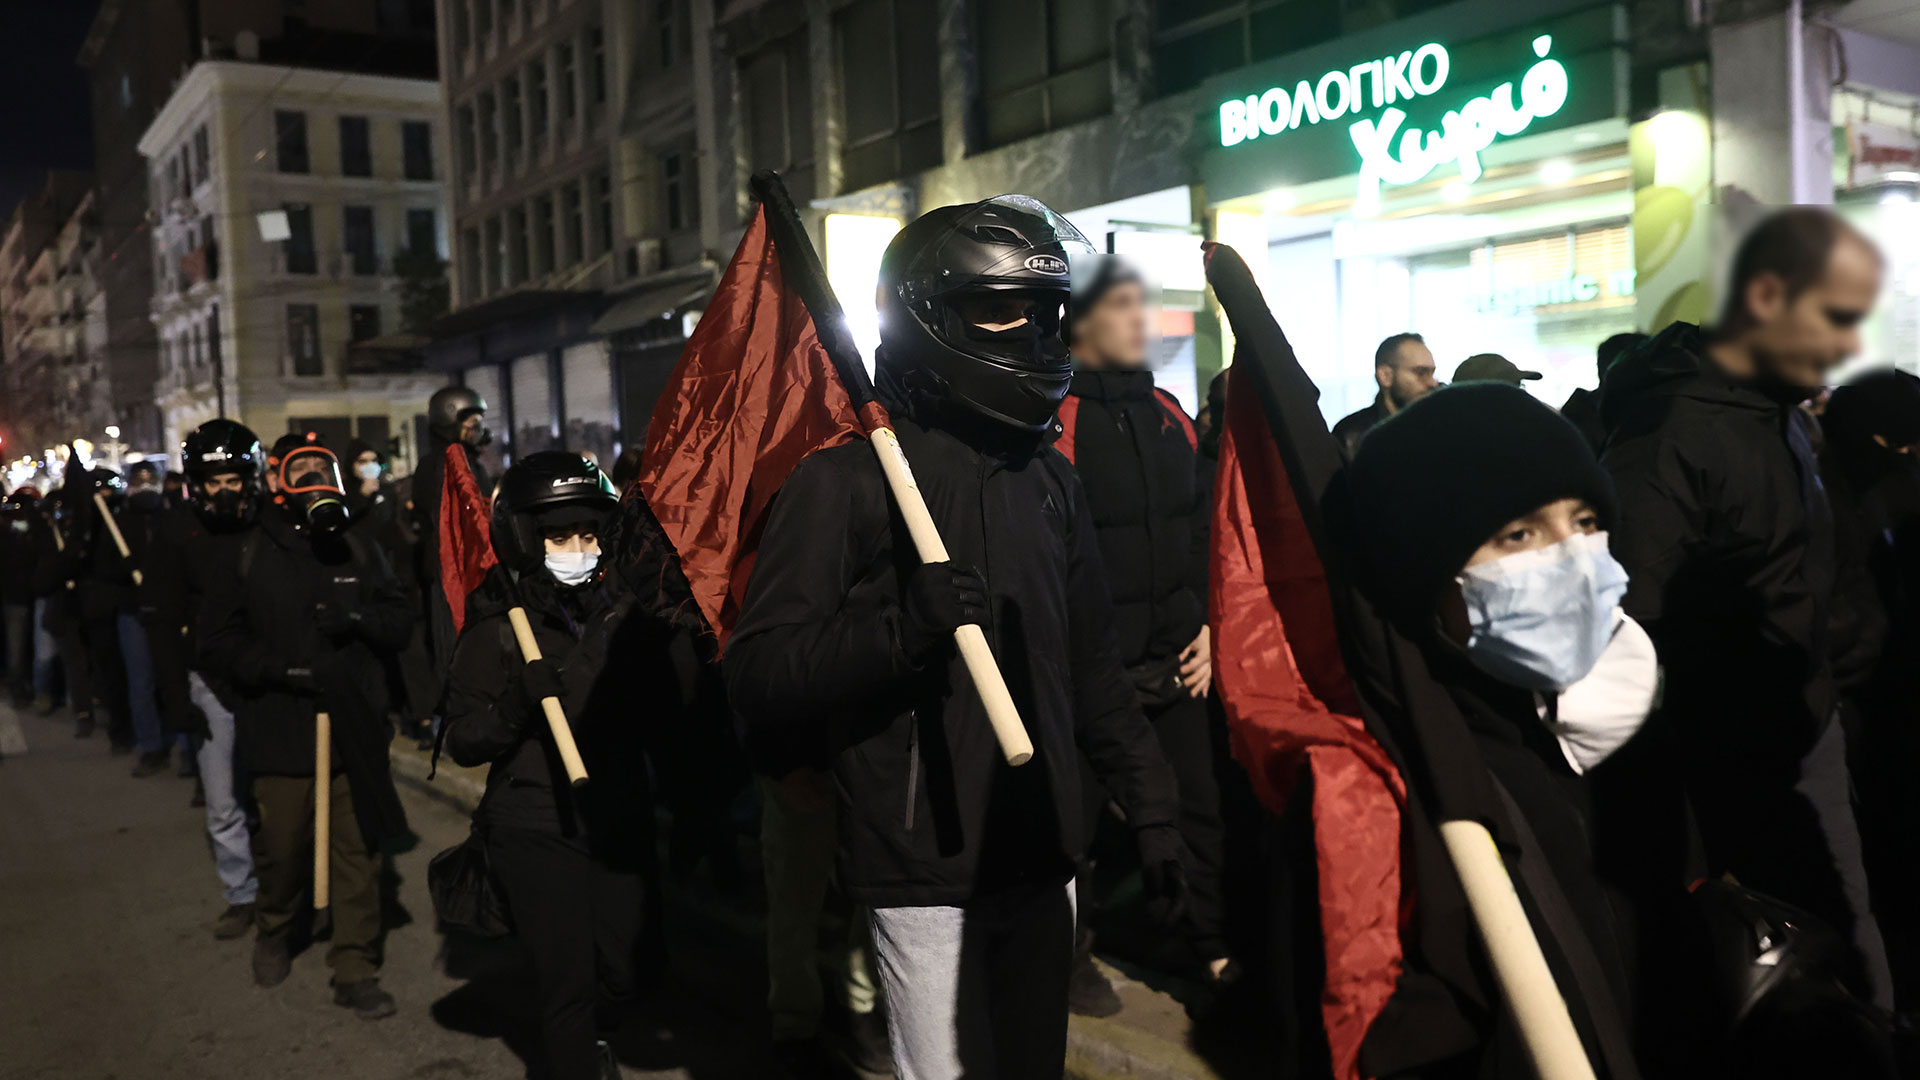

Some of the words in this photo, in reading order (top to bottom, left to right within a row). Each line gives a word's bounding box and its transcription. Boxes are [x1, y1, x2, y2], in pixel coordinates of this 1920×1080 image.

[1219, 42, 1450, 147] ΒΙΟΛΟΓΙΚΟ
[1349, 34, 1568, 217] Χωριό
[1032, 258, 1064, 271] HJC
